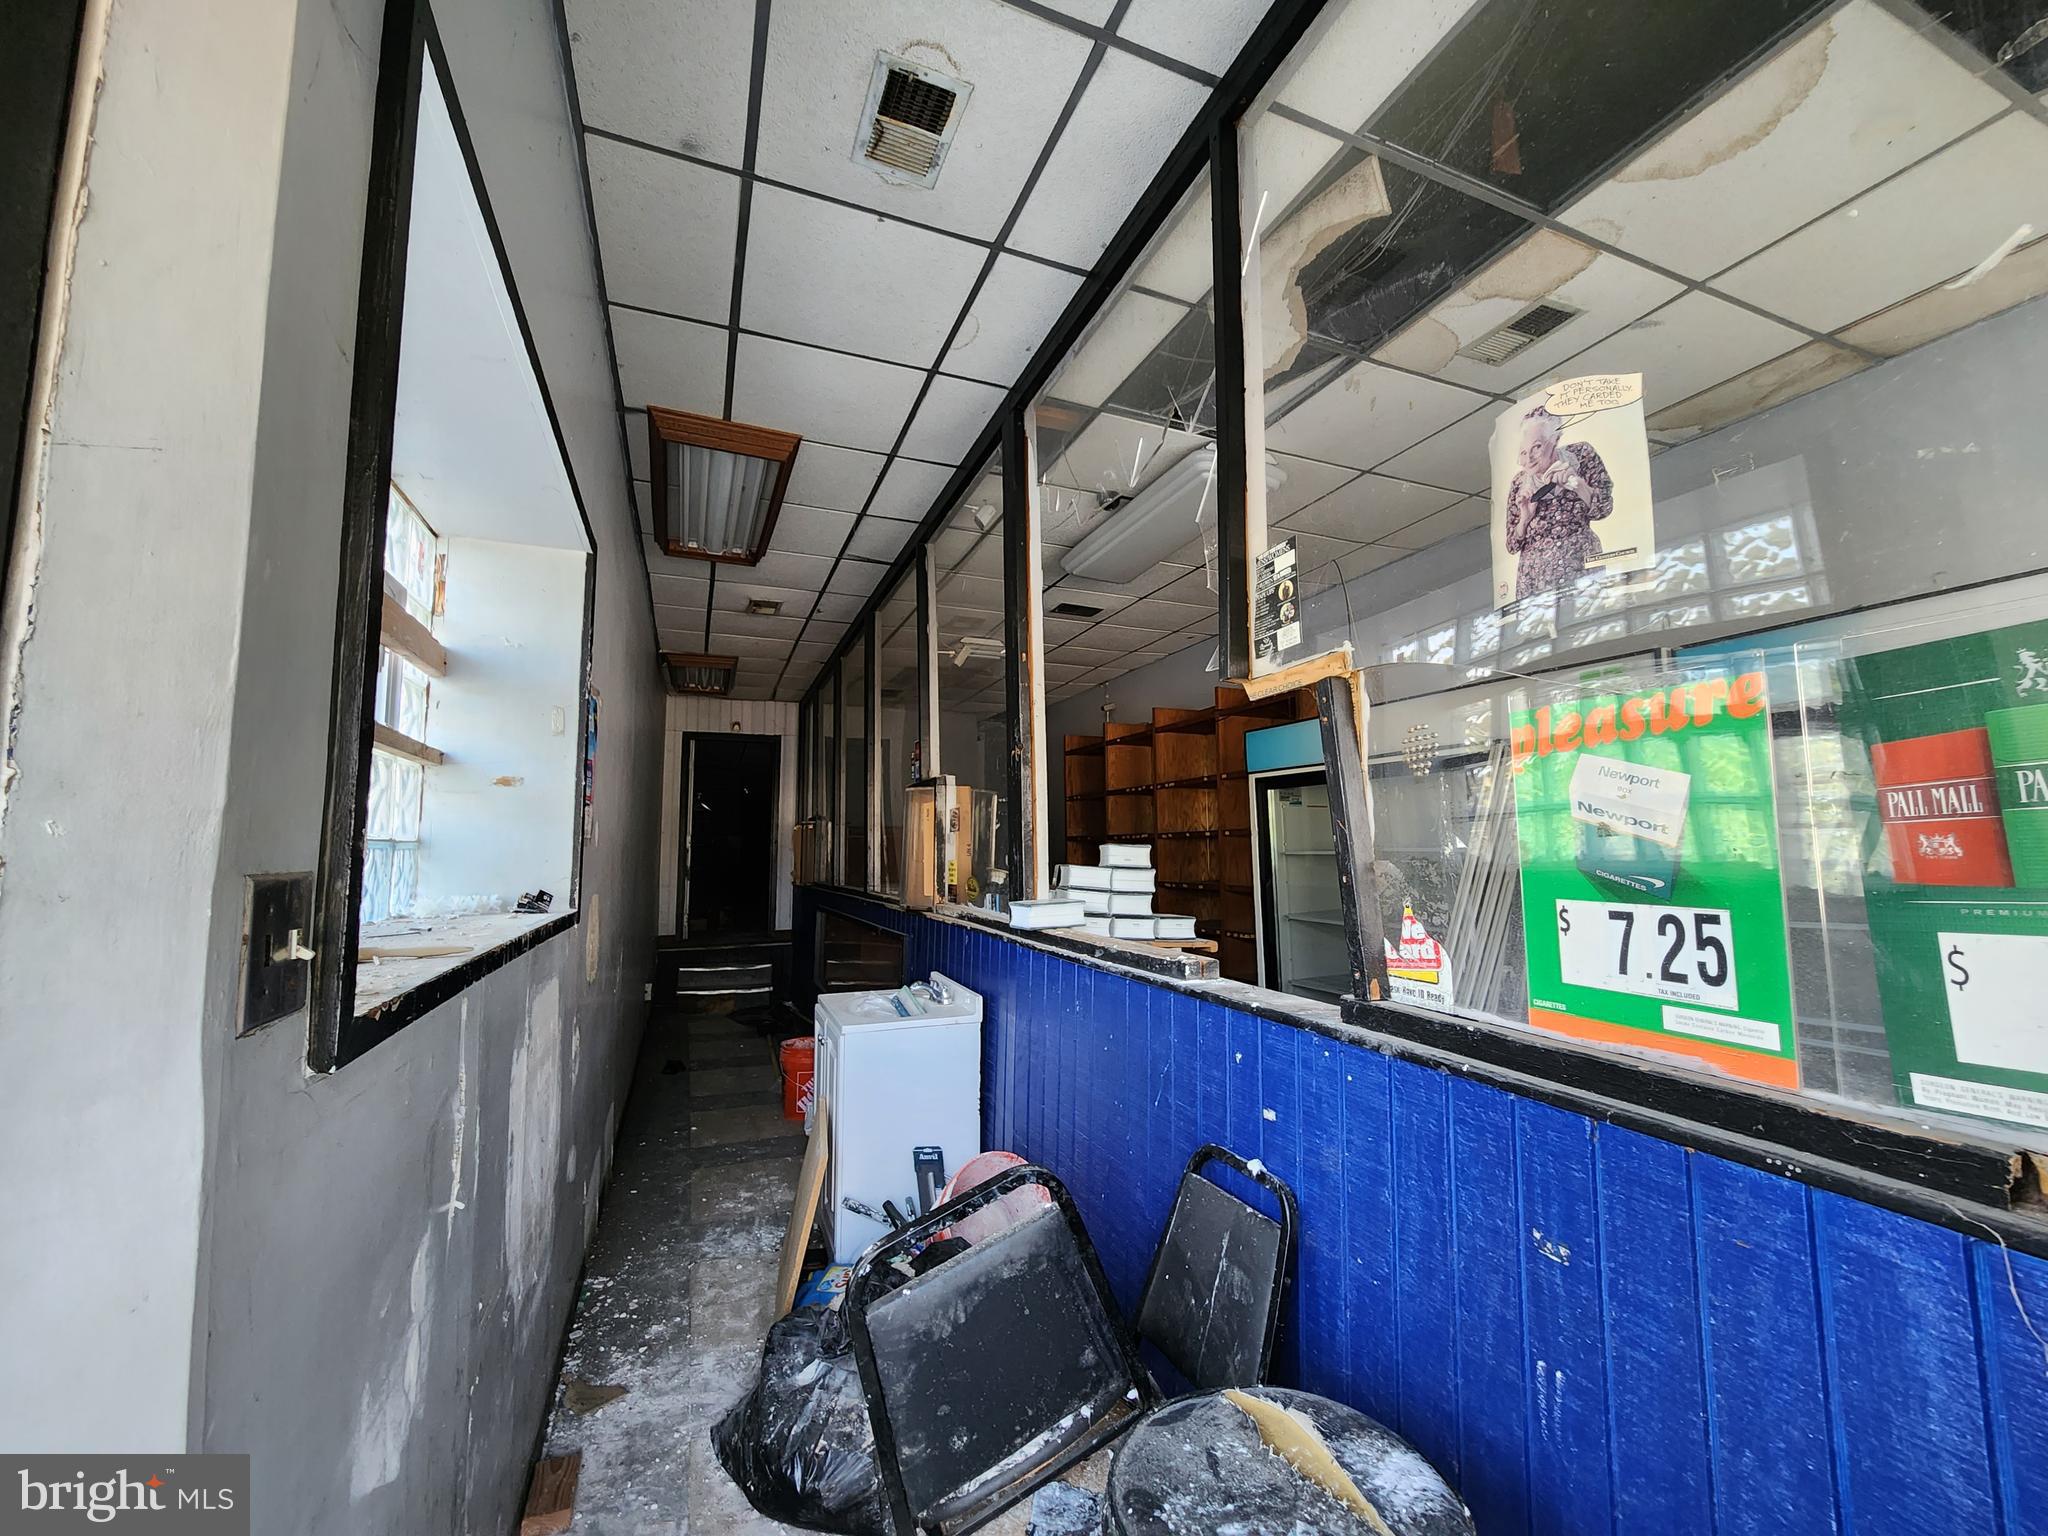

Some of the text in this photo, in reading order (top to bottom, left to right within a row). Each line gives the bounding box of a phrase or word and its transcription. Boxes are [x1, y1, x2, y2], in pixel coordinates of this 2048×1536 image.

[1560, 390, 1570, 399] IT
[1563, 379, 1593, 391] DON'T
[1553, 392, 1622, 408] THEY CARDED
[1580, 400, 1594, 408] ME
[1512, 672, 1767, 773] pleasure
[1598, 766, 1661, 789] Newport
[1886, 785, 1984, 817] PALL MALL
[1577, 800, 1669, 835] Newport
[1595, 869, 1648, 891] CIGARETTES
[1608, 910, 1728, 987] 7.25
[1947, 945, 1970, 991] $
[1658, 988, 1701, 1001] TAX INCLUDED
